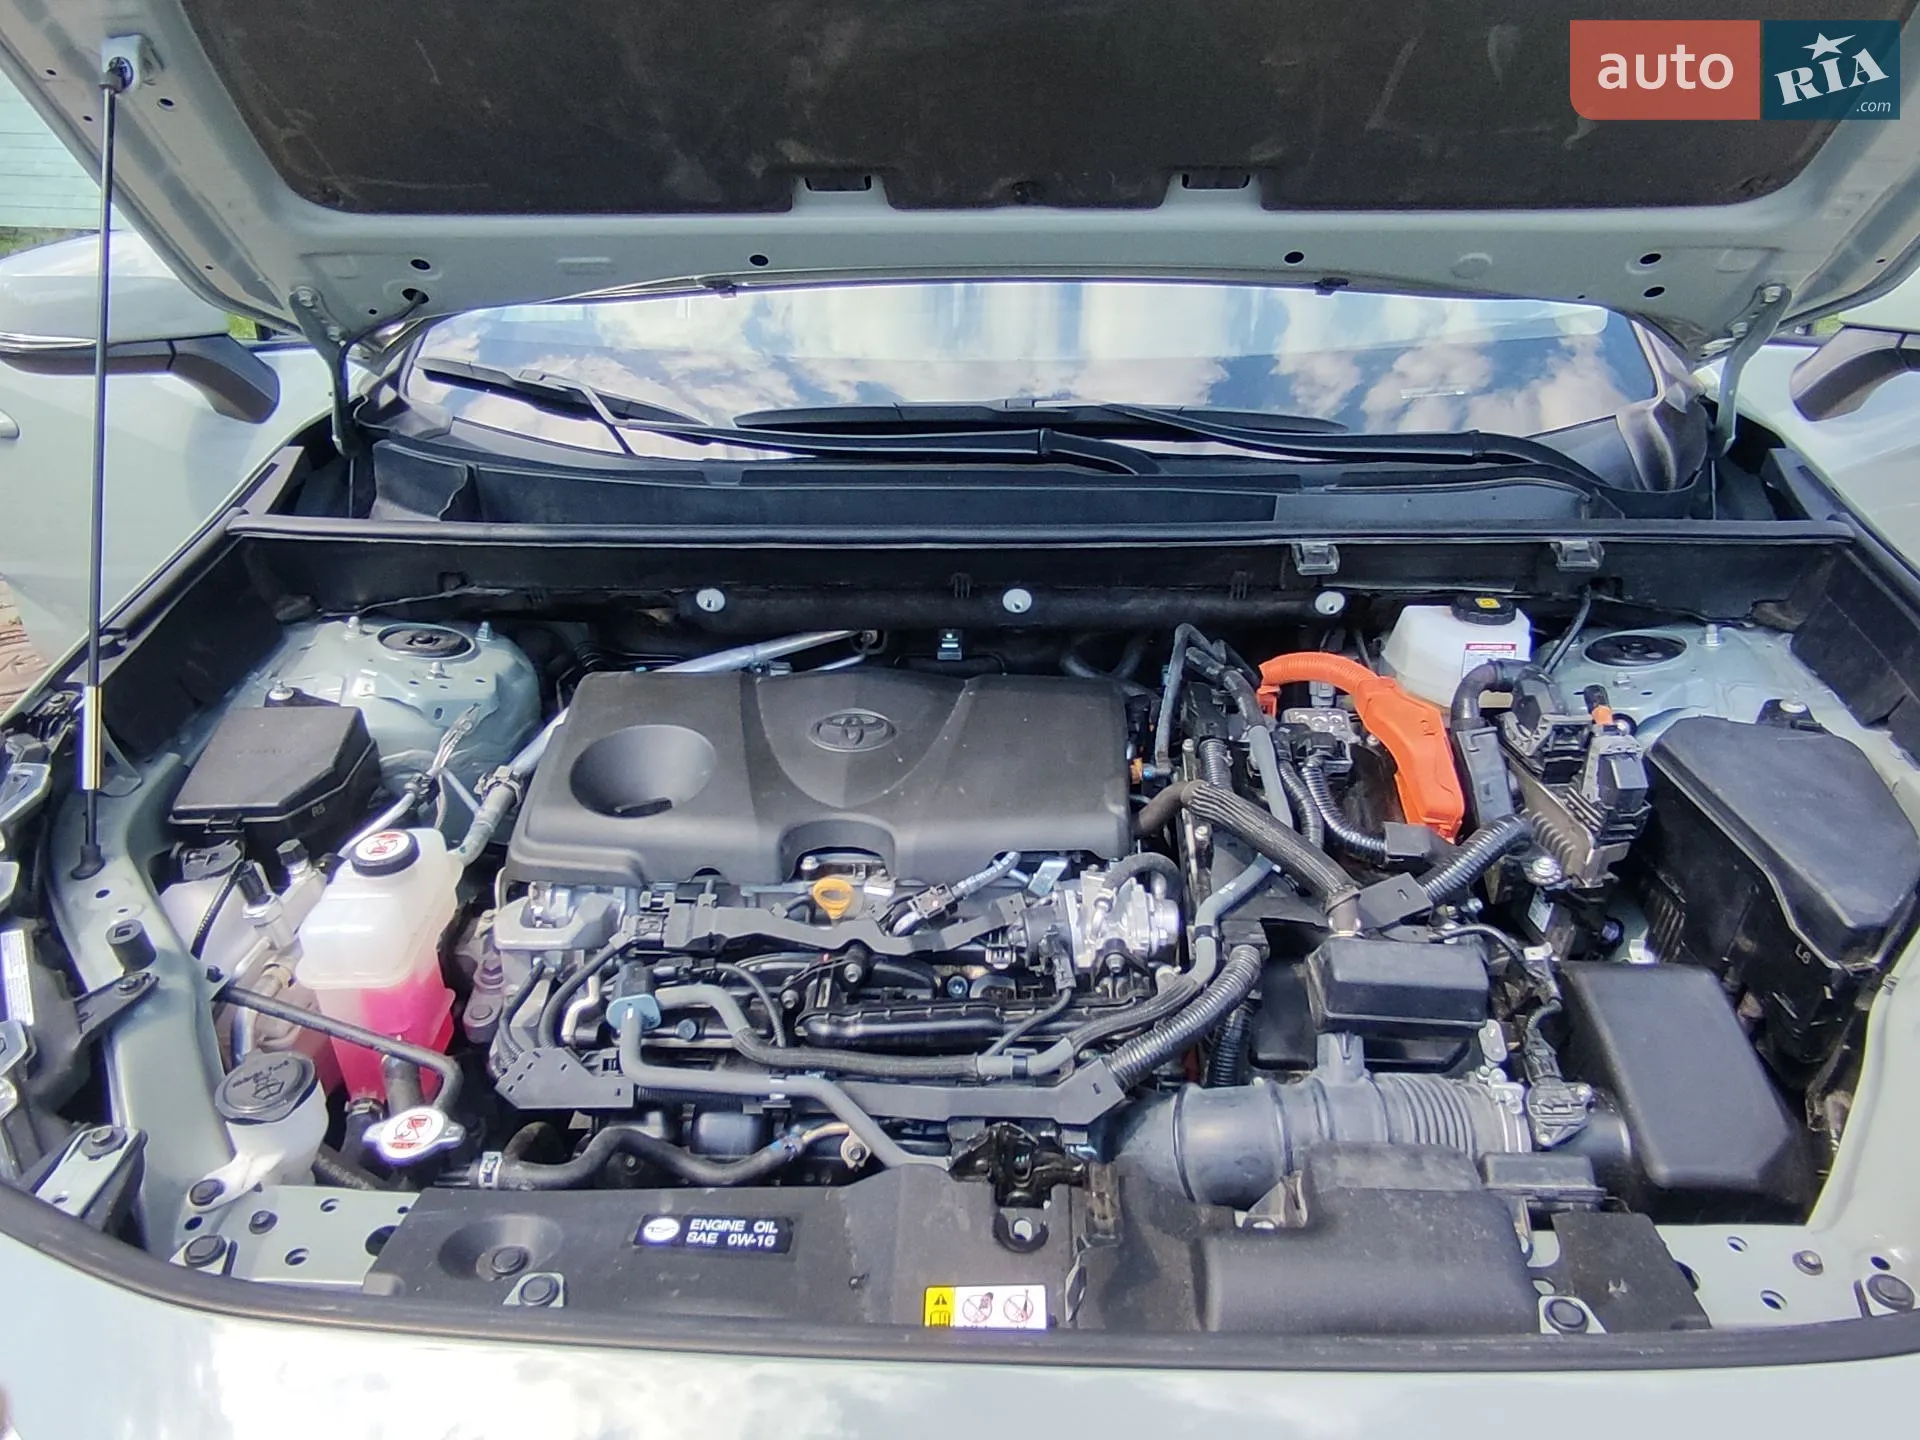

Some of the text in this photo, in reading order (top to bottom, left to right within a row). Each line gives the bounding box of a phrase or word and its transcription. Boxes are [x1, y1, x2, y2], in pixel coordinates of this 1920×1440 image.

[689, 1218, 746, 1232] ENGINE
[753, 1220, 779, 1234] OIL
[686, 1231, 718, 1244] SAE
[727, 1234, 776, 1247] 0W-16
